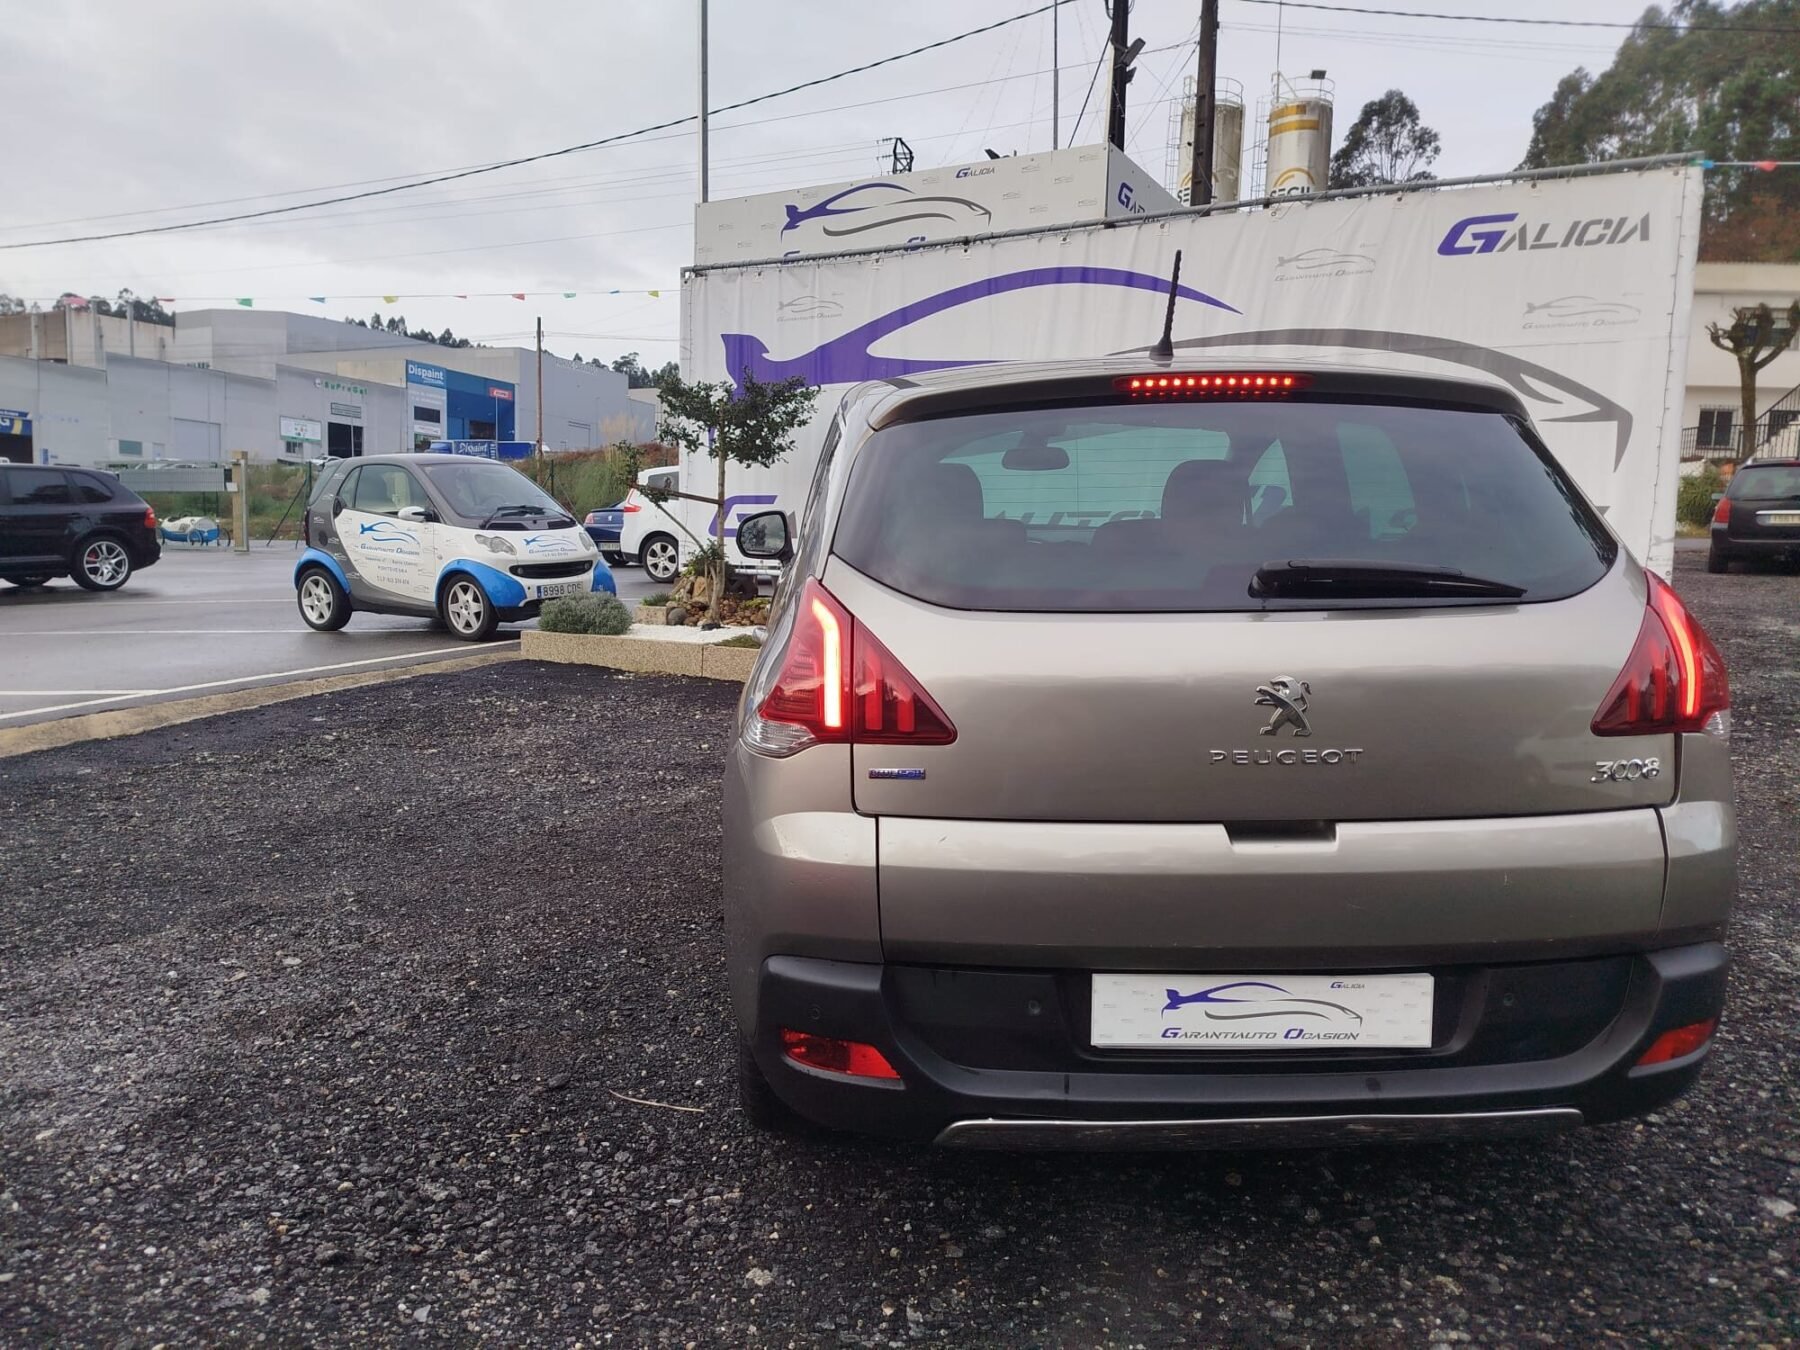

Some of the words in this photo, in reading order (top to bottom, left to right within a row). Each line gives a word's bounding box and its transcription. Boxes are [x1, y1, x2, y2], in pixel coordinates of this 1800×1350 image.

[956, 167, 996, 179] GALICIA
[1437, 212, 1650, 256] GALICIA
[408, 364, 443, 380] Dispaint
[542, 585, 565, 597] 8998
[1209, 748, 1364, 765] PEUGEOT
[1590, 757, 1660, 783] 3008
[1330, 981, 1365, 989] GALICIA
[1161, 1027, 1277, 1040] GARANTIAUTO
[1283, 1028, 1360, 1041] OCASION
